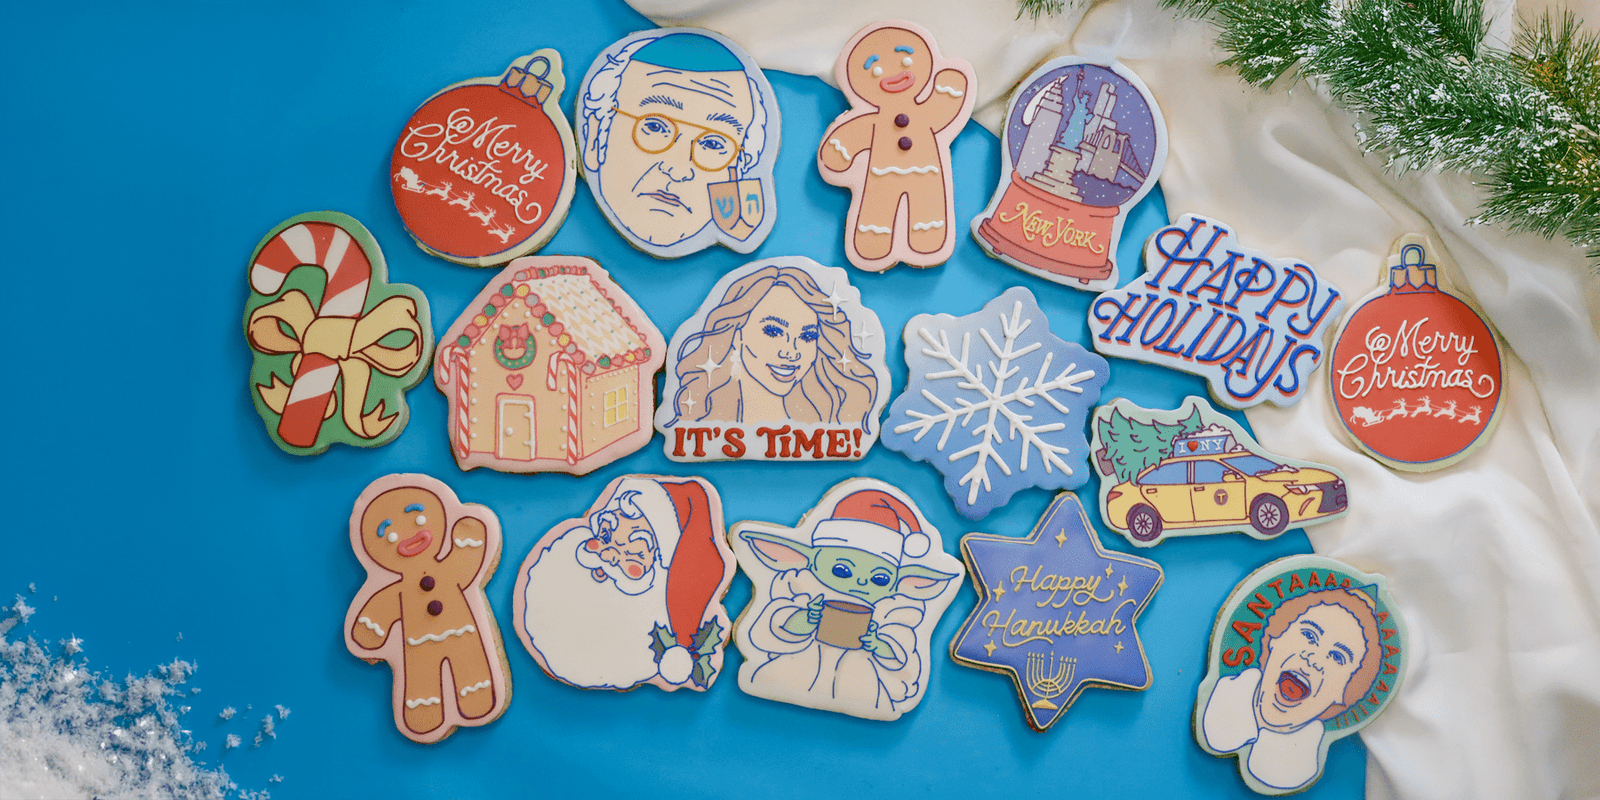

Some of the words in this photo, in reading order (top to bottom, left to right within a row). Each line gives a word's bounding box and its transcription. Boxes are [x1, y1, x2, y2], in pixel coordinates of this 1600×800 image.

[446, 108, 545, 181] Merry
[400, 122, 542, 224] Christmas
[1145, 218, 1341, 335] HAPPY
[1093, 290, 1320, 399] HOLIDAYS
[1365, 317, 1478, 366] Merry
[1336, 350, 1495, 399] Christmas
[672, 427, 747, 458] IT'S
[1200, 438, 1224, 452] NY
[1010, 564, 1115, 608] Happy
[981, 599, 1137, 648] Hanukkah
